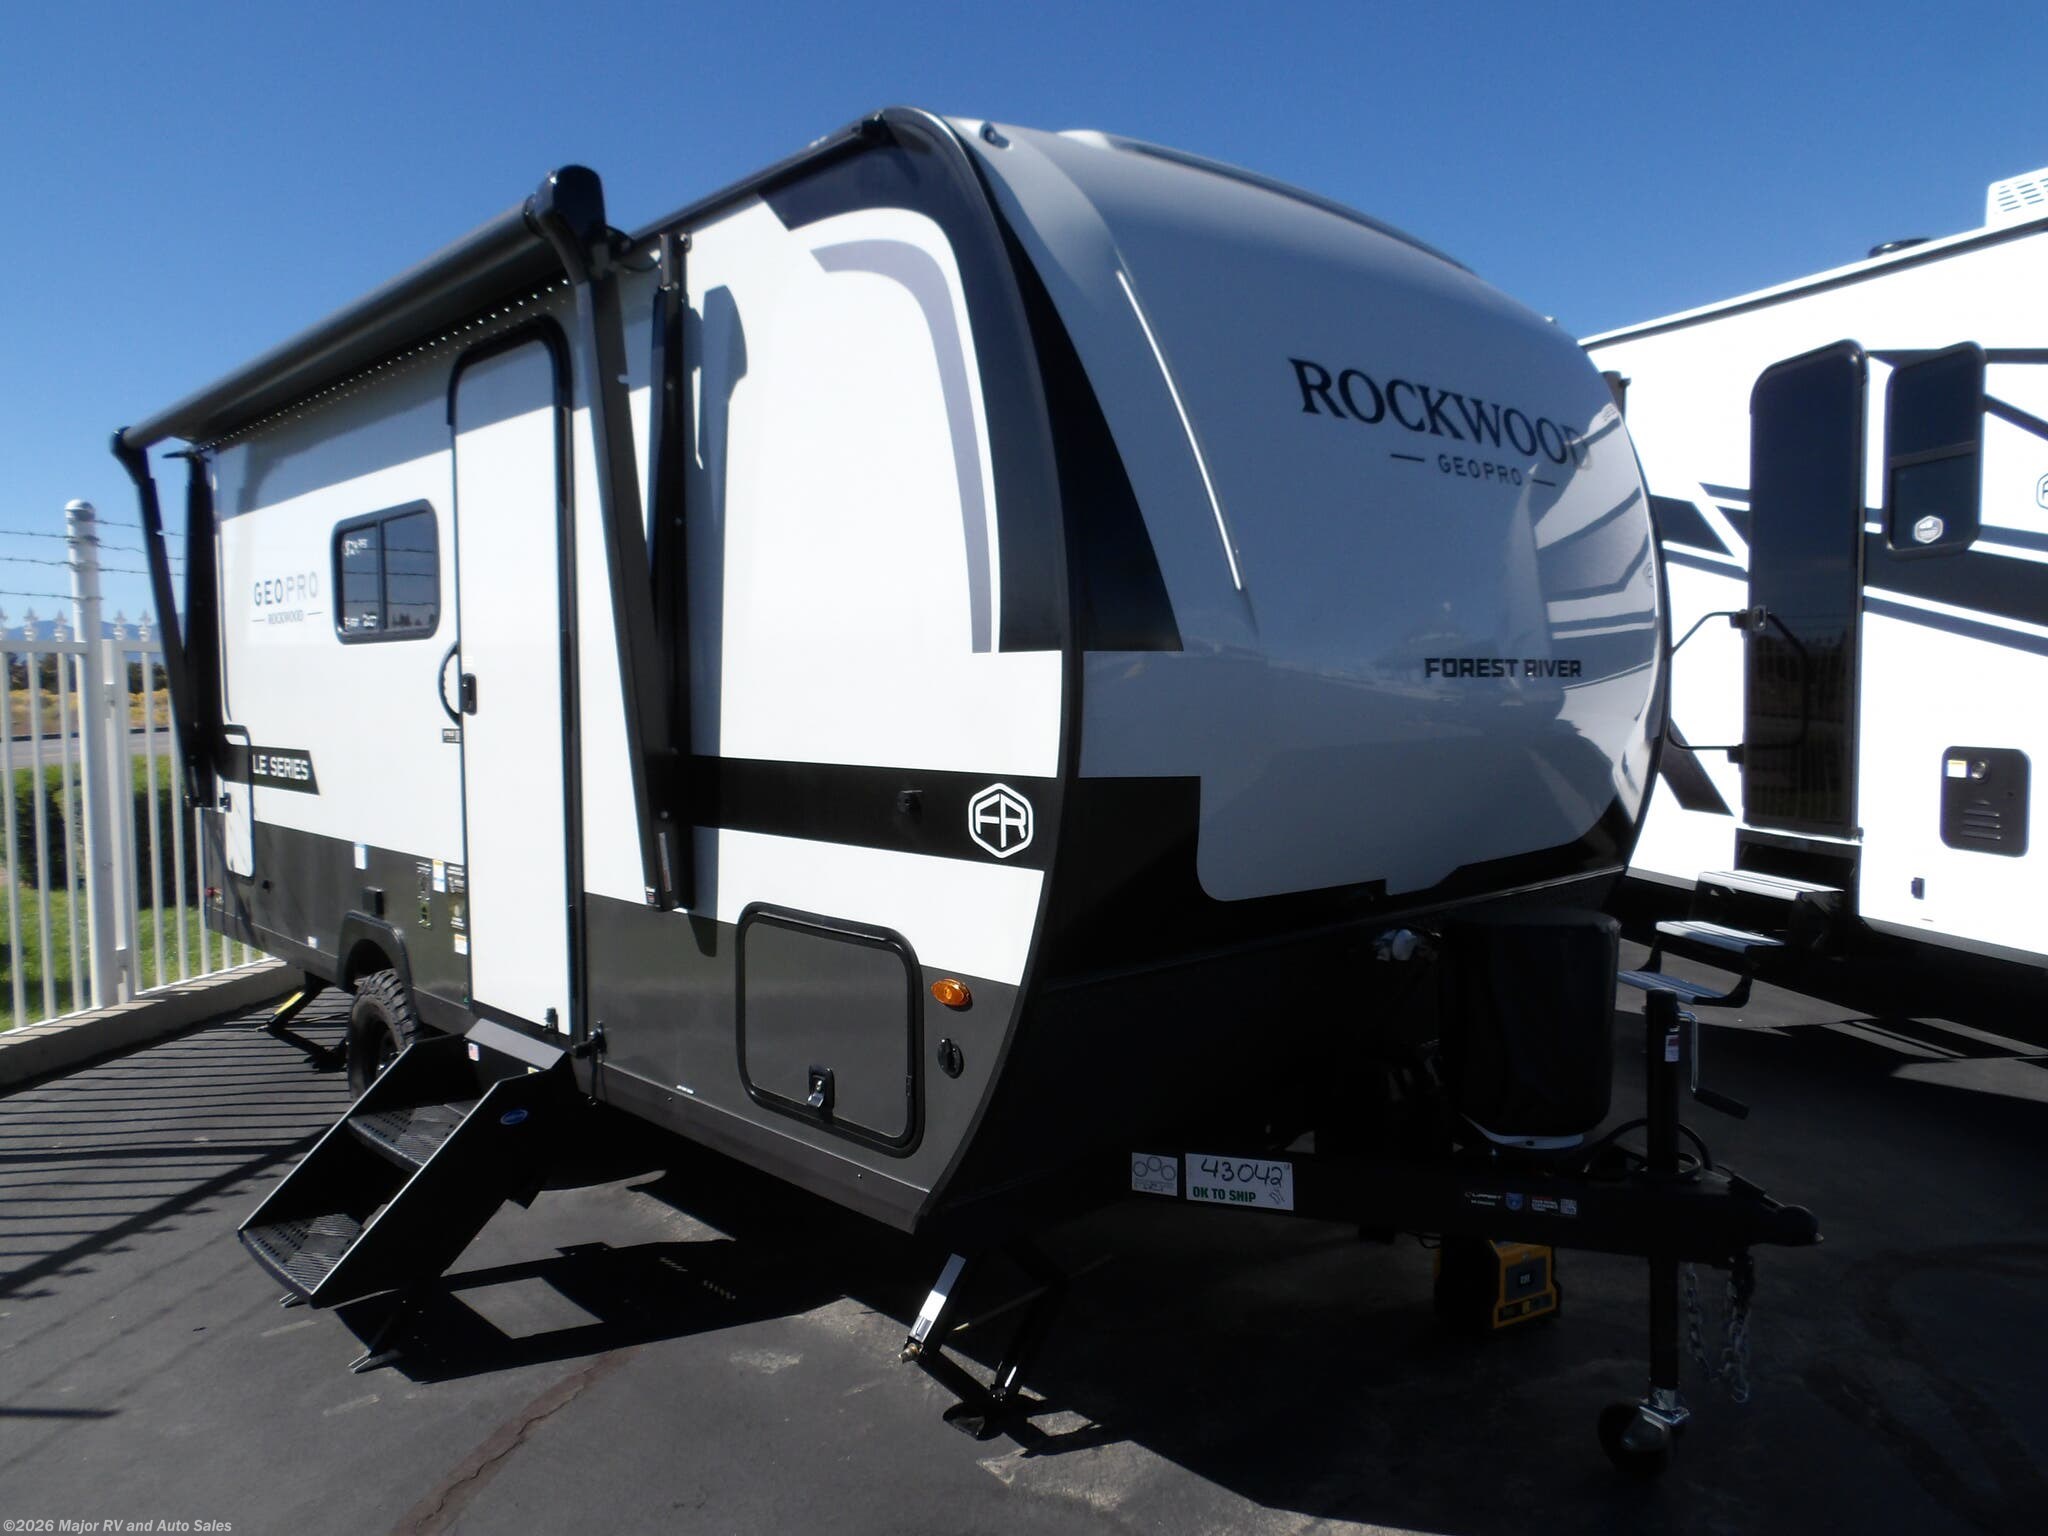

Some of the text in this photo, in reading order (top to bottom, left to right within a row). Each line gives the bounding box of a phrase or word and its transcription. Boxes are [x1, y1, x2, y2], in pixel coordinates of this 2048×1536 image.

[1438, 453, 1522, 486] GEOPRO
[1424, 657, 1582, 678] FOREST RIVER
[252, 754, 309, 780] LE SERIES
[1200, 1157, 1283, 1189] 43042
[1193, 1185, 1209, 1199] OK
[1212, 1188, 1226, 1201] TO
[1229, 1190, 1257, 1203] SHIP
